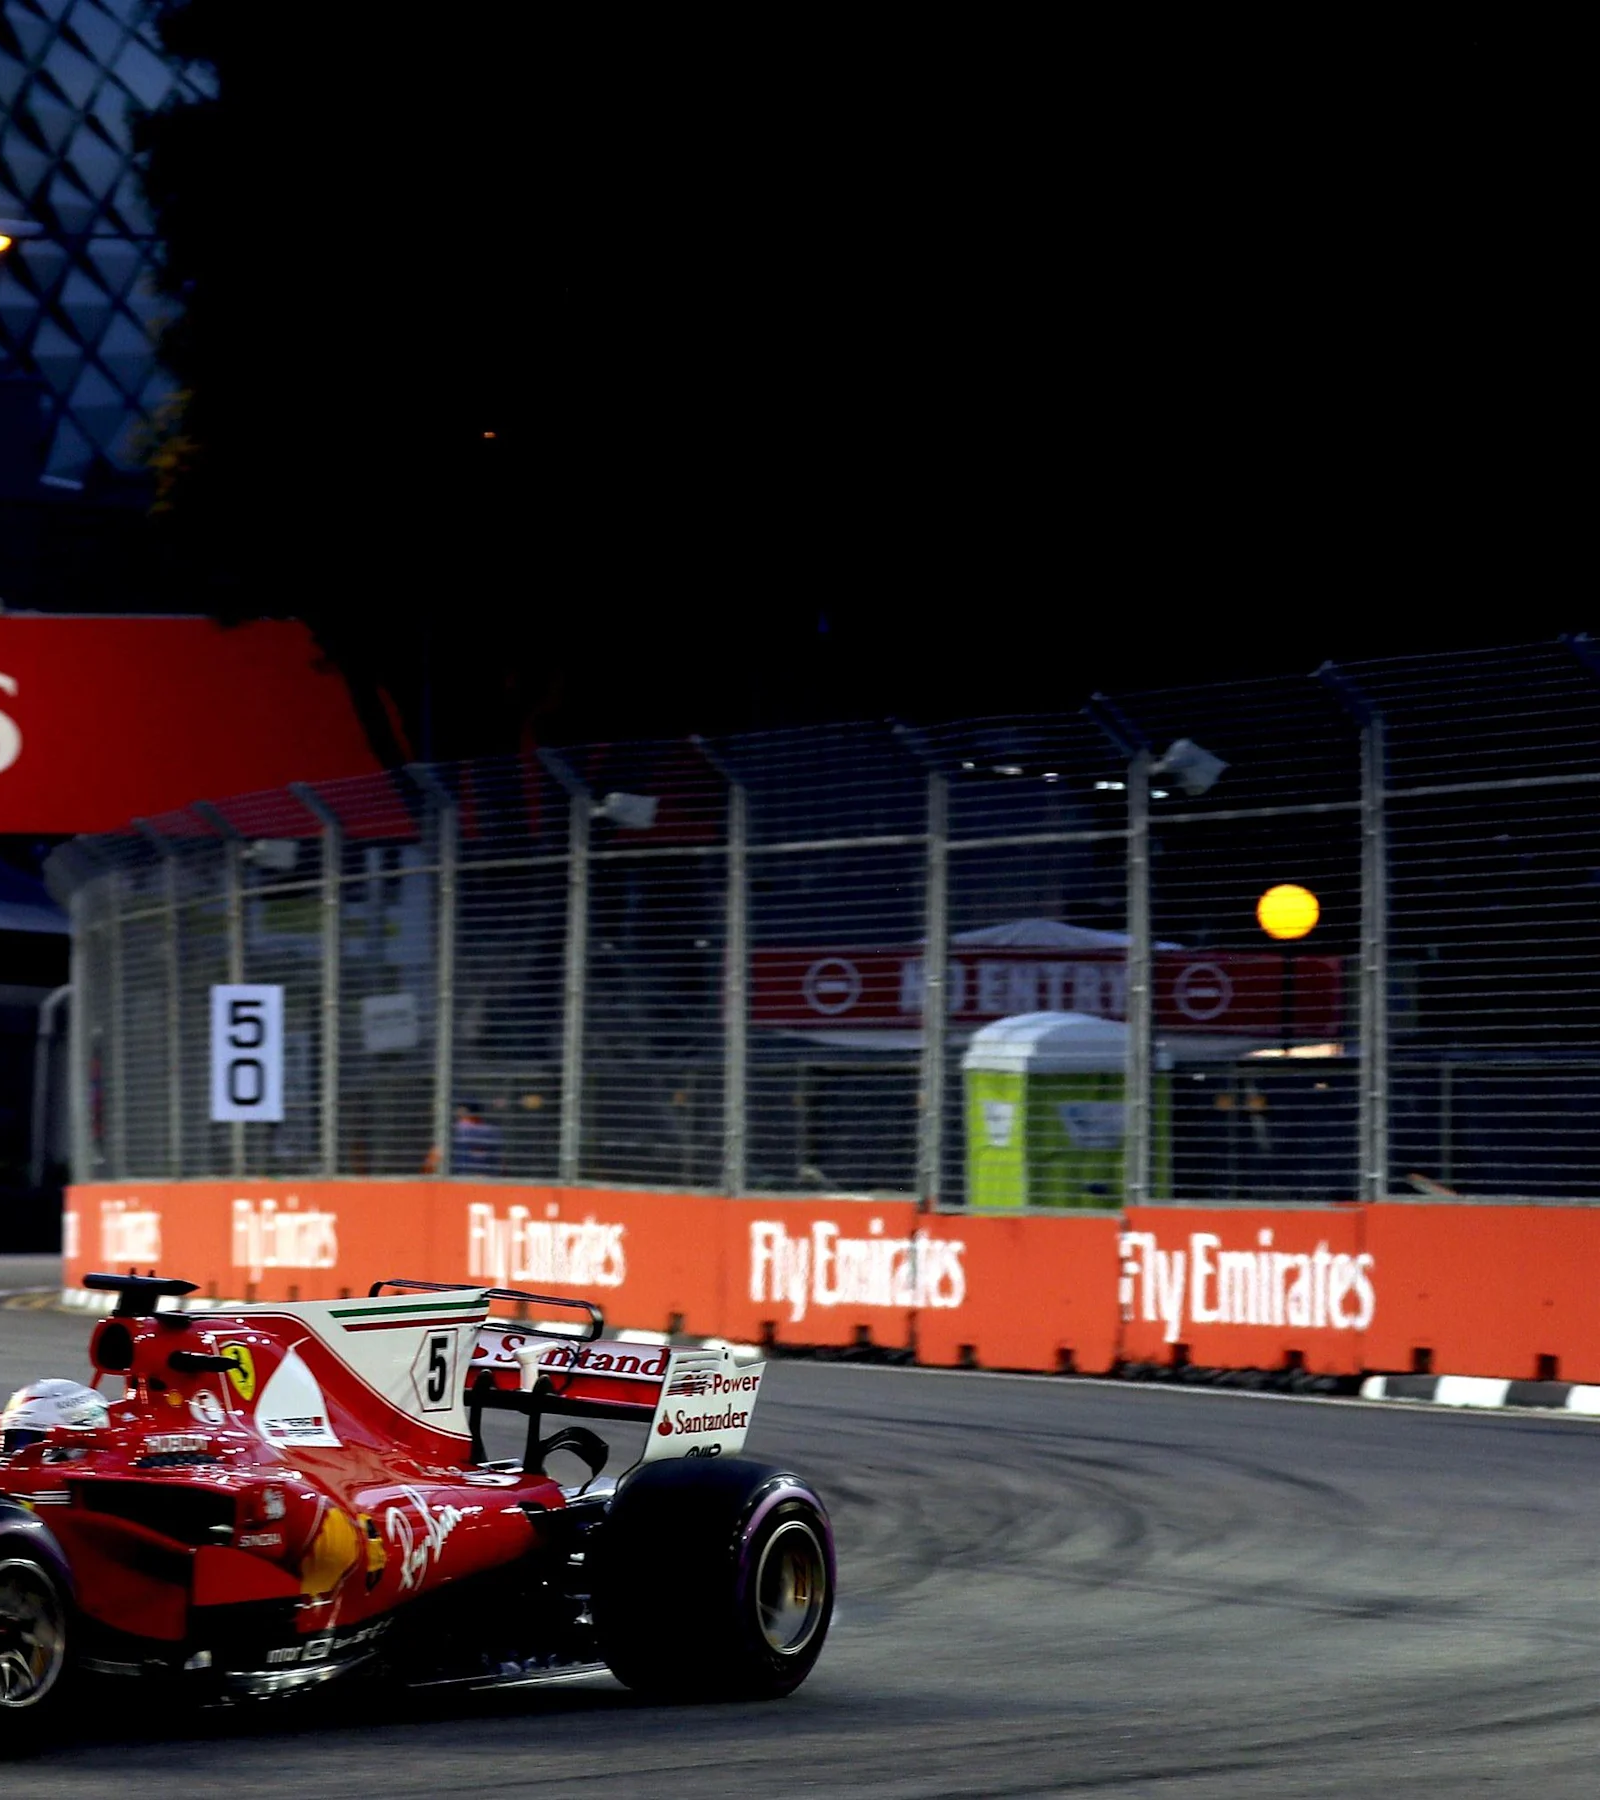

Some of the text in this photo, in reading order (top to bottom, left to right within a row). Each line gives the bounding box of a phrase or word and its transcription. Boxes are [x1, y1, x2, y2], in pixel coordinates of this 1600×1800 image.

[509, 1202, 627, 1287] Emirates
[749, 1217, 967, 1322] Fly Emirates
[1117, 1227, 1376, 1343] Fly Emirates
[428, 1337, 447, 1402] 5
[713, 1374, 760, 1395] Power
[675, 1402, 749, 1435] Santander
